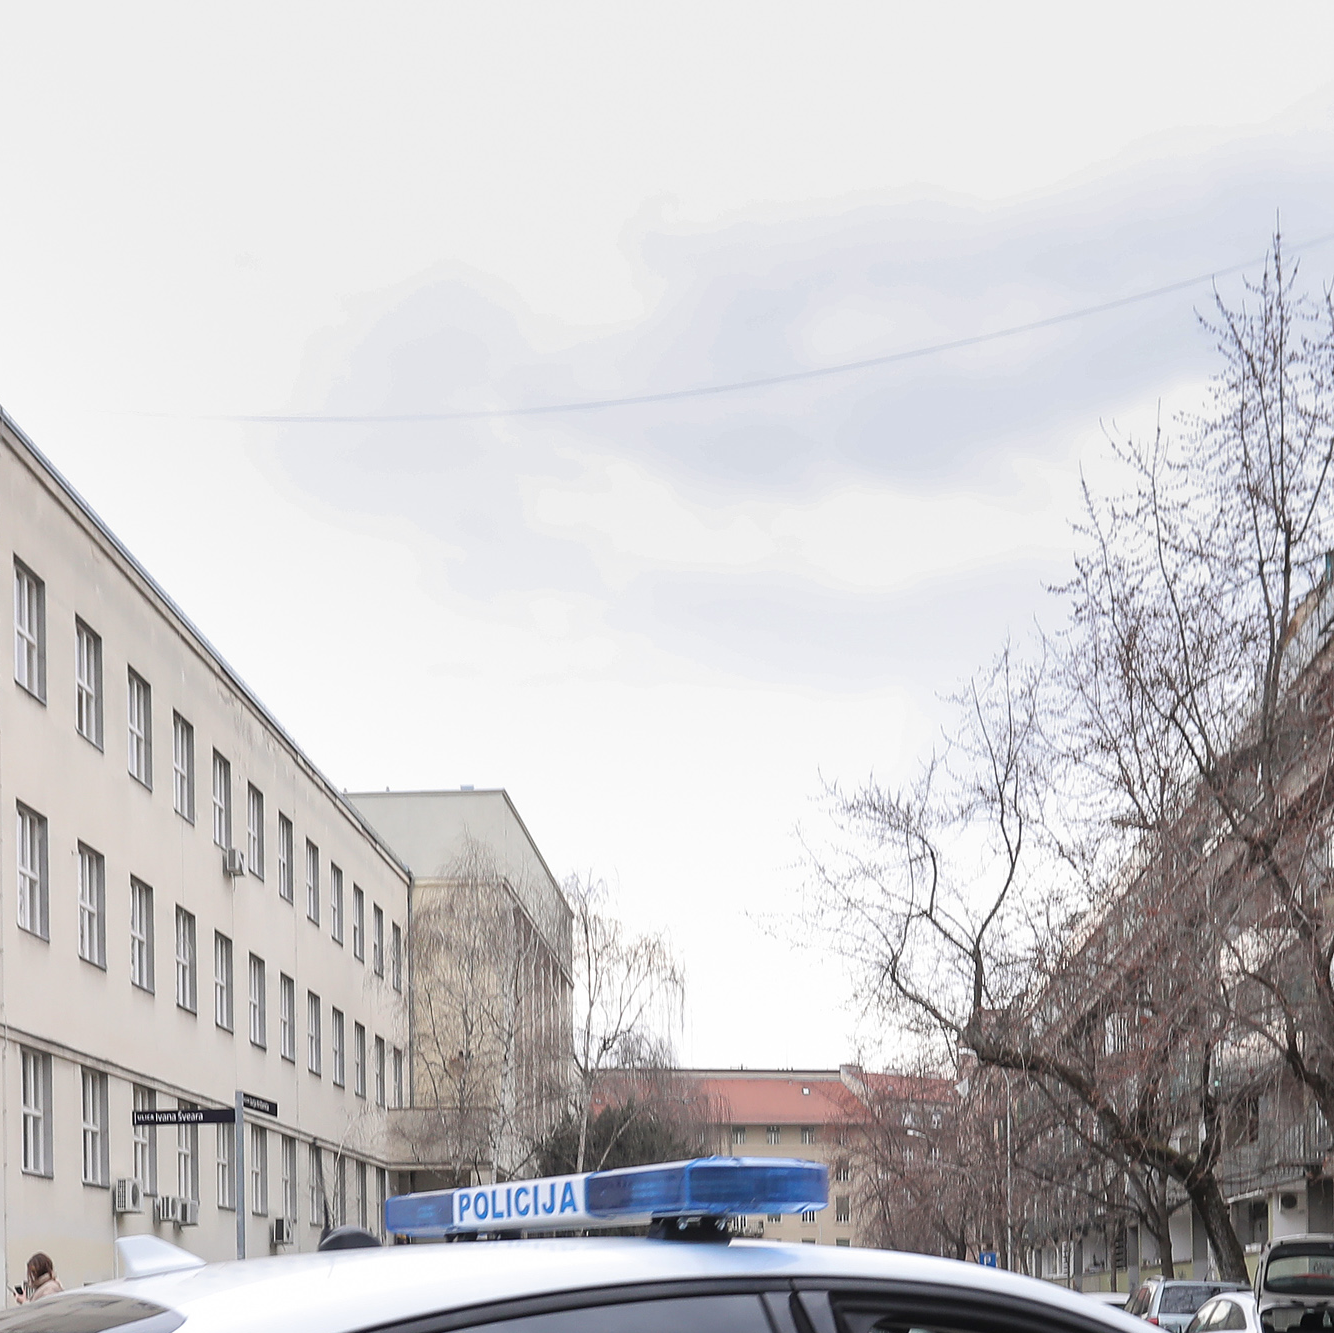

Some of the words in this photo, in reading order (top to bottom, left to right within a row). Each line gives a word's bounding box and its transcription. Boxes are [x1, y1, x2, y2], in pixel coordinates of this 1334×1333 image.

[155, 1112, 176, 1122] Ivana
[177, 1110, 204, 1122] Šveara
[459, 1182, 577, 1221] POLICIJA
